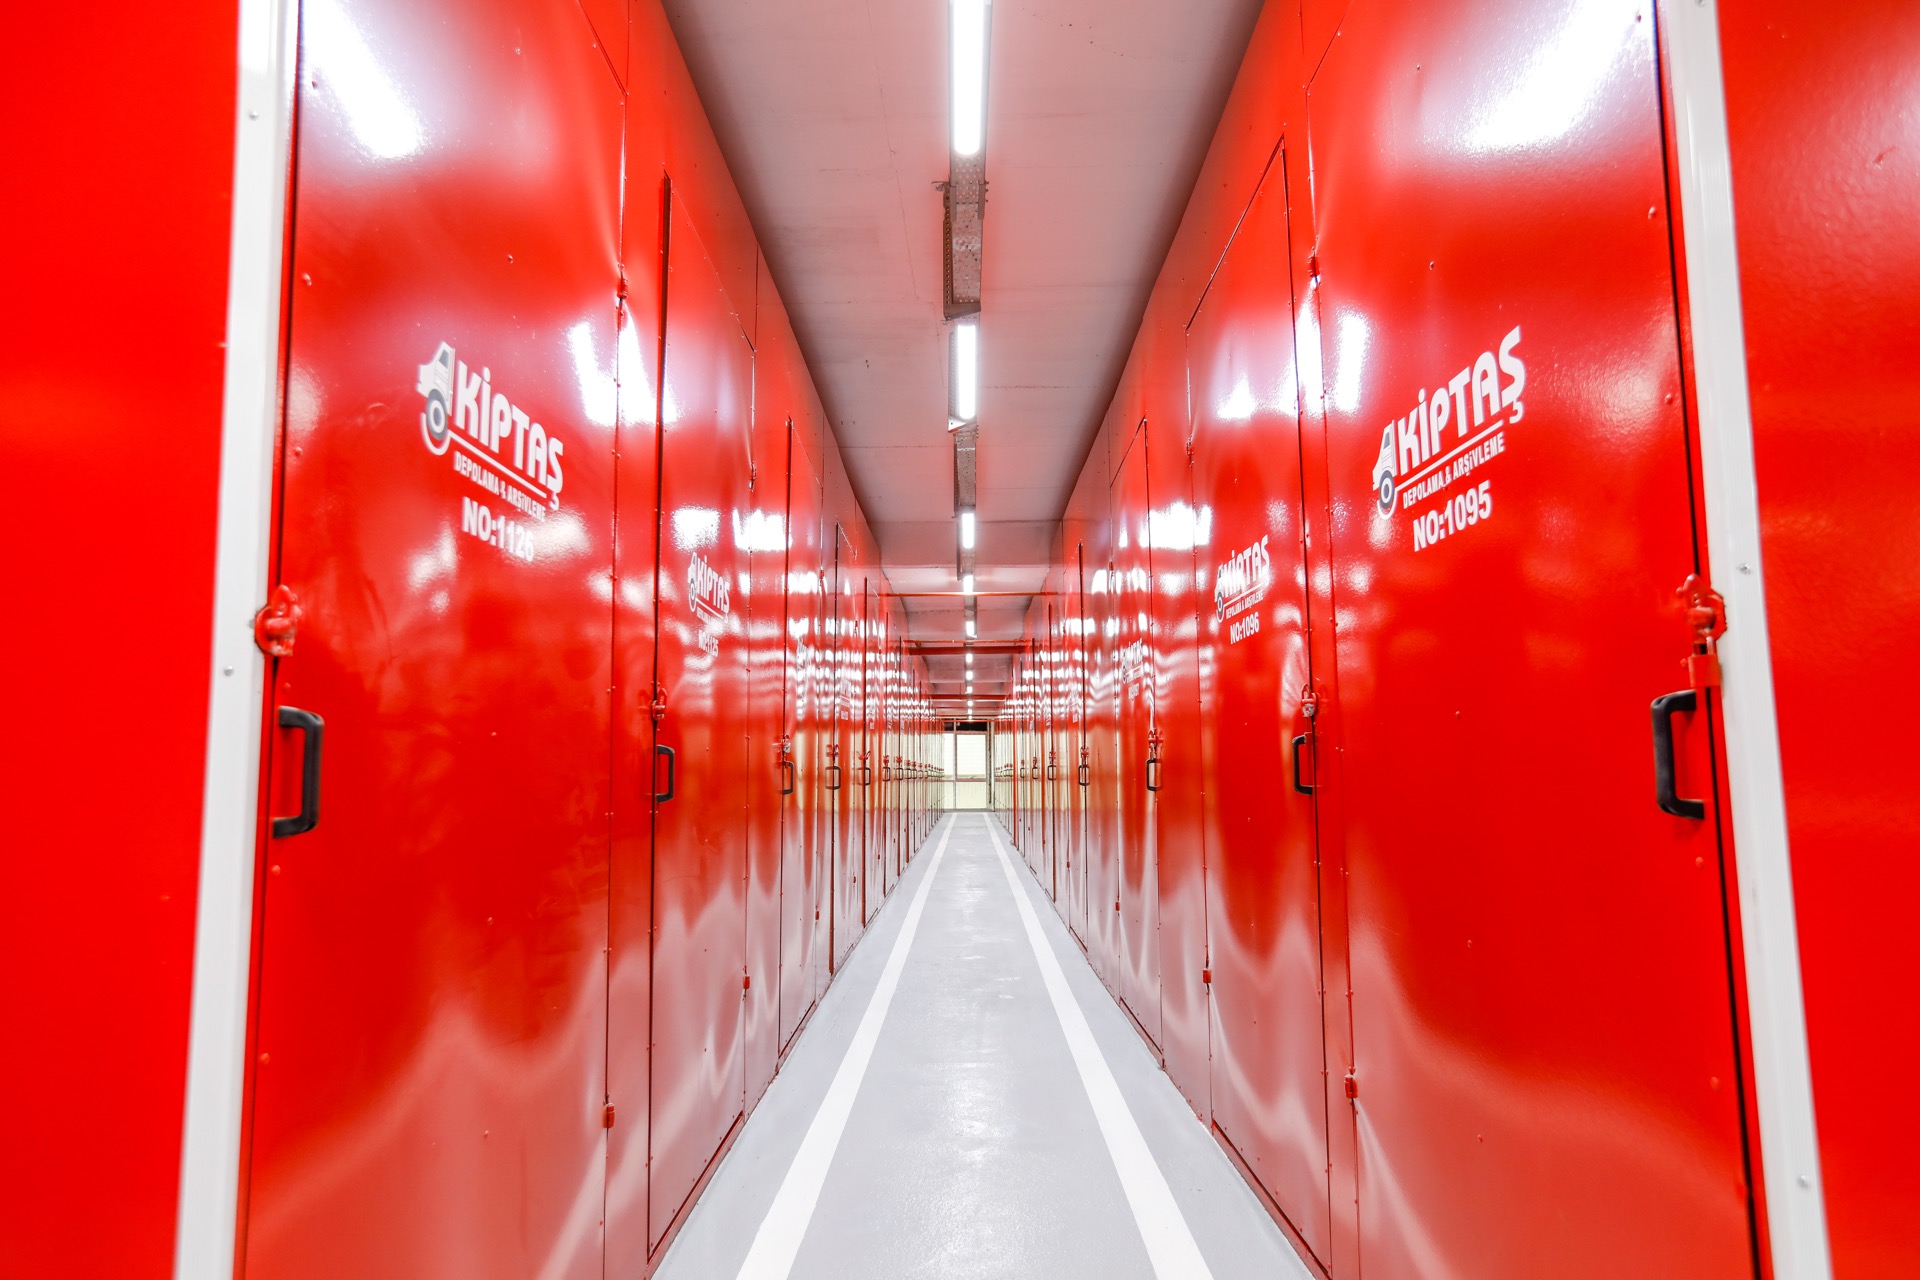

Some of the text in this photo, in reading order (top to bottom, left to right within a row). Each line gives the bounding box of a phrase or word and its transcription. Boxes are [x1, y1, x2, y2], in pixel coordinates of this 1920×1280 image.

[1397, 325, 1526, 476] KİPTAŞ
[454, 360, 564, 511] KİPTAŞ
[454, 450, 500, 496] DEPOLAMA
[1402, 470, 1445, 510] DEPOLAMA
[1445, 465, 1452, 488] &
[462, 495, 534, 563] NO:1126
[1413, 479, 1492, 552] NO:1095
[1230, 611, 1260, 645] NO:1096
